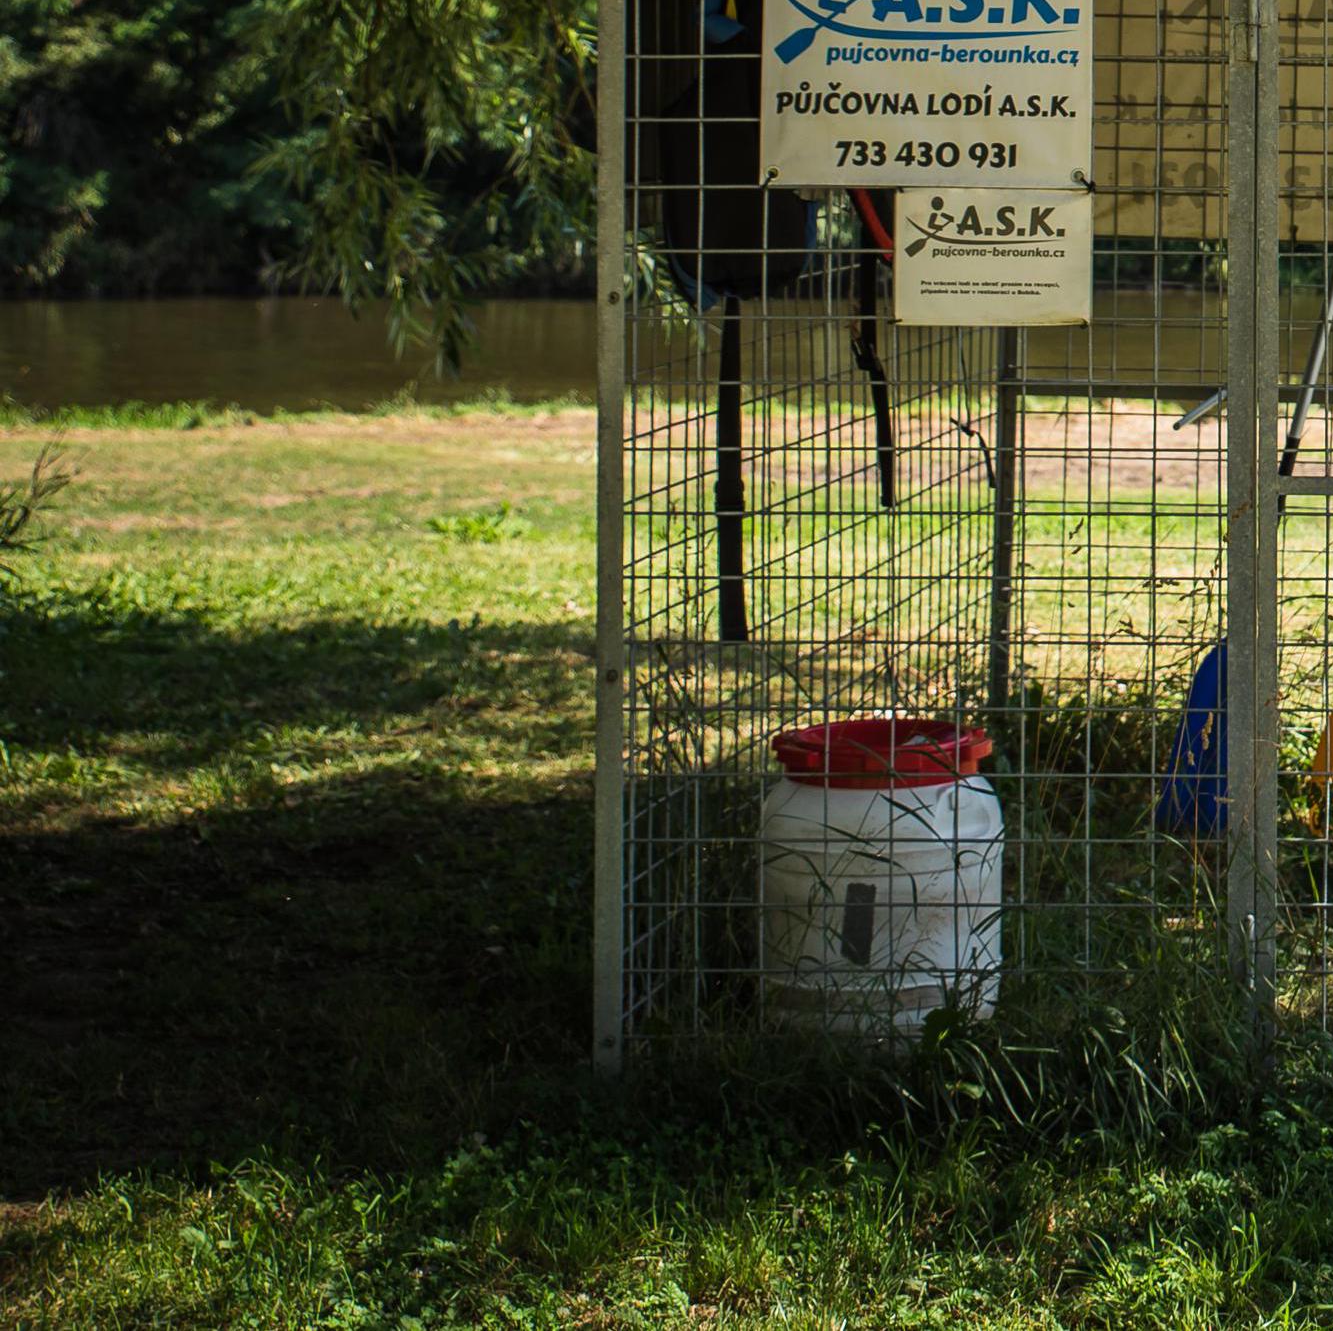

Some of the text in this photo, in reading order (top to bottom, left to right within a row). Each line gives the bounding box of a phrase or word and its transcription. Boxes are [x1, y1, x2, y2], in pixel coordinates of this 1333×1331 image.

[826, 42, 1079, 67] pujcovna-berounka.cz
[776, 81, 1077, 118] PŮJČOVNA LODÍ A.S.K.
[835, 140, 1018, 169] 733 430 931
[956, 205, 1066, 237] A.S.K.
[932, 246, 1065, 258] pujcovna-berounka.cz
